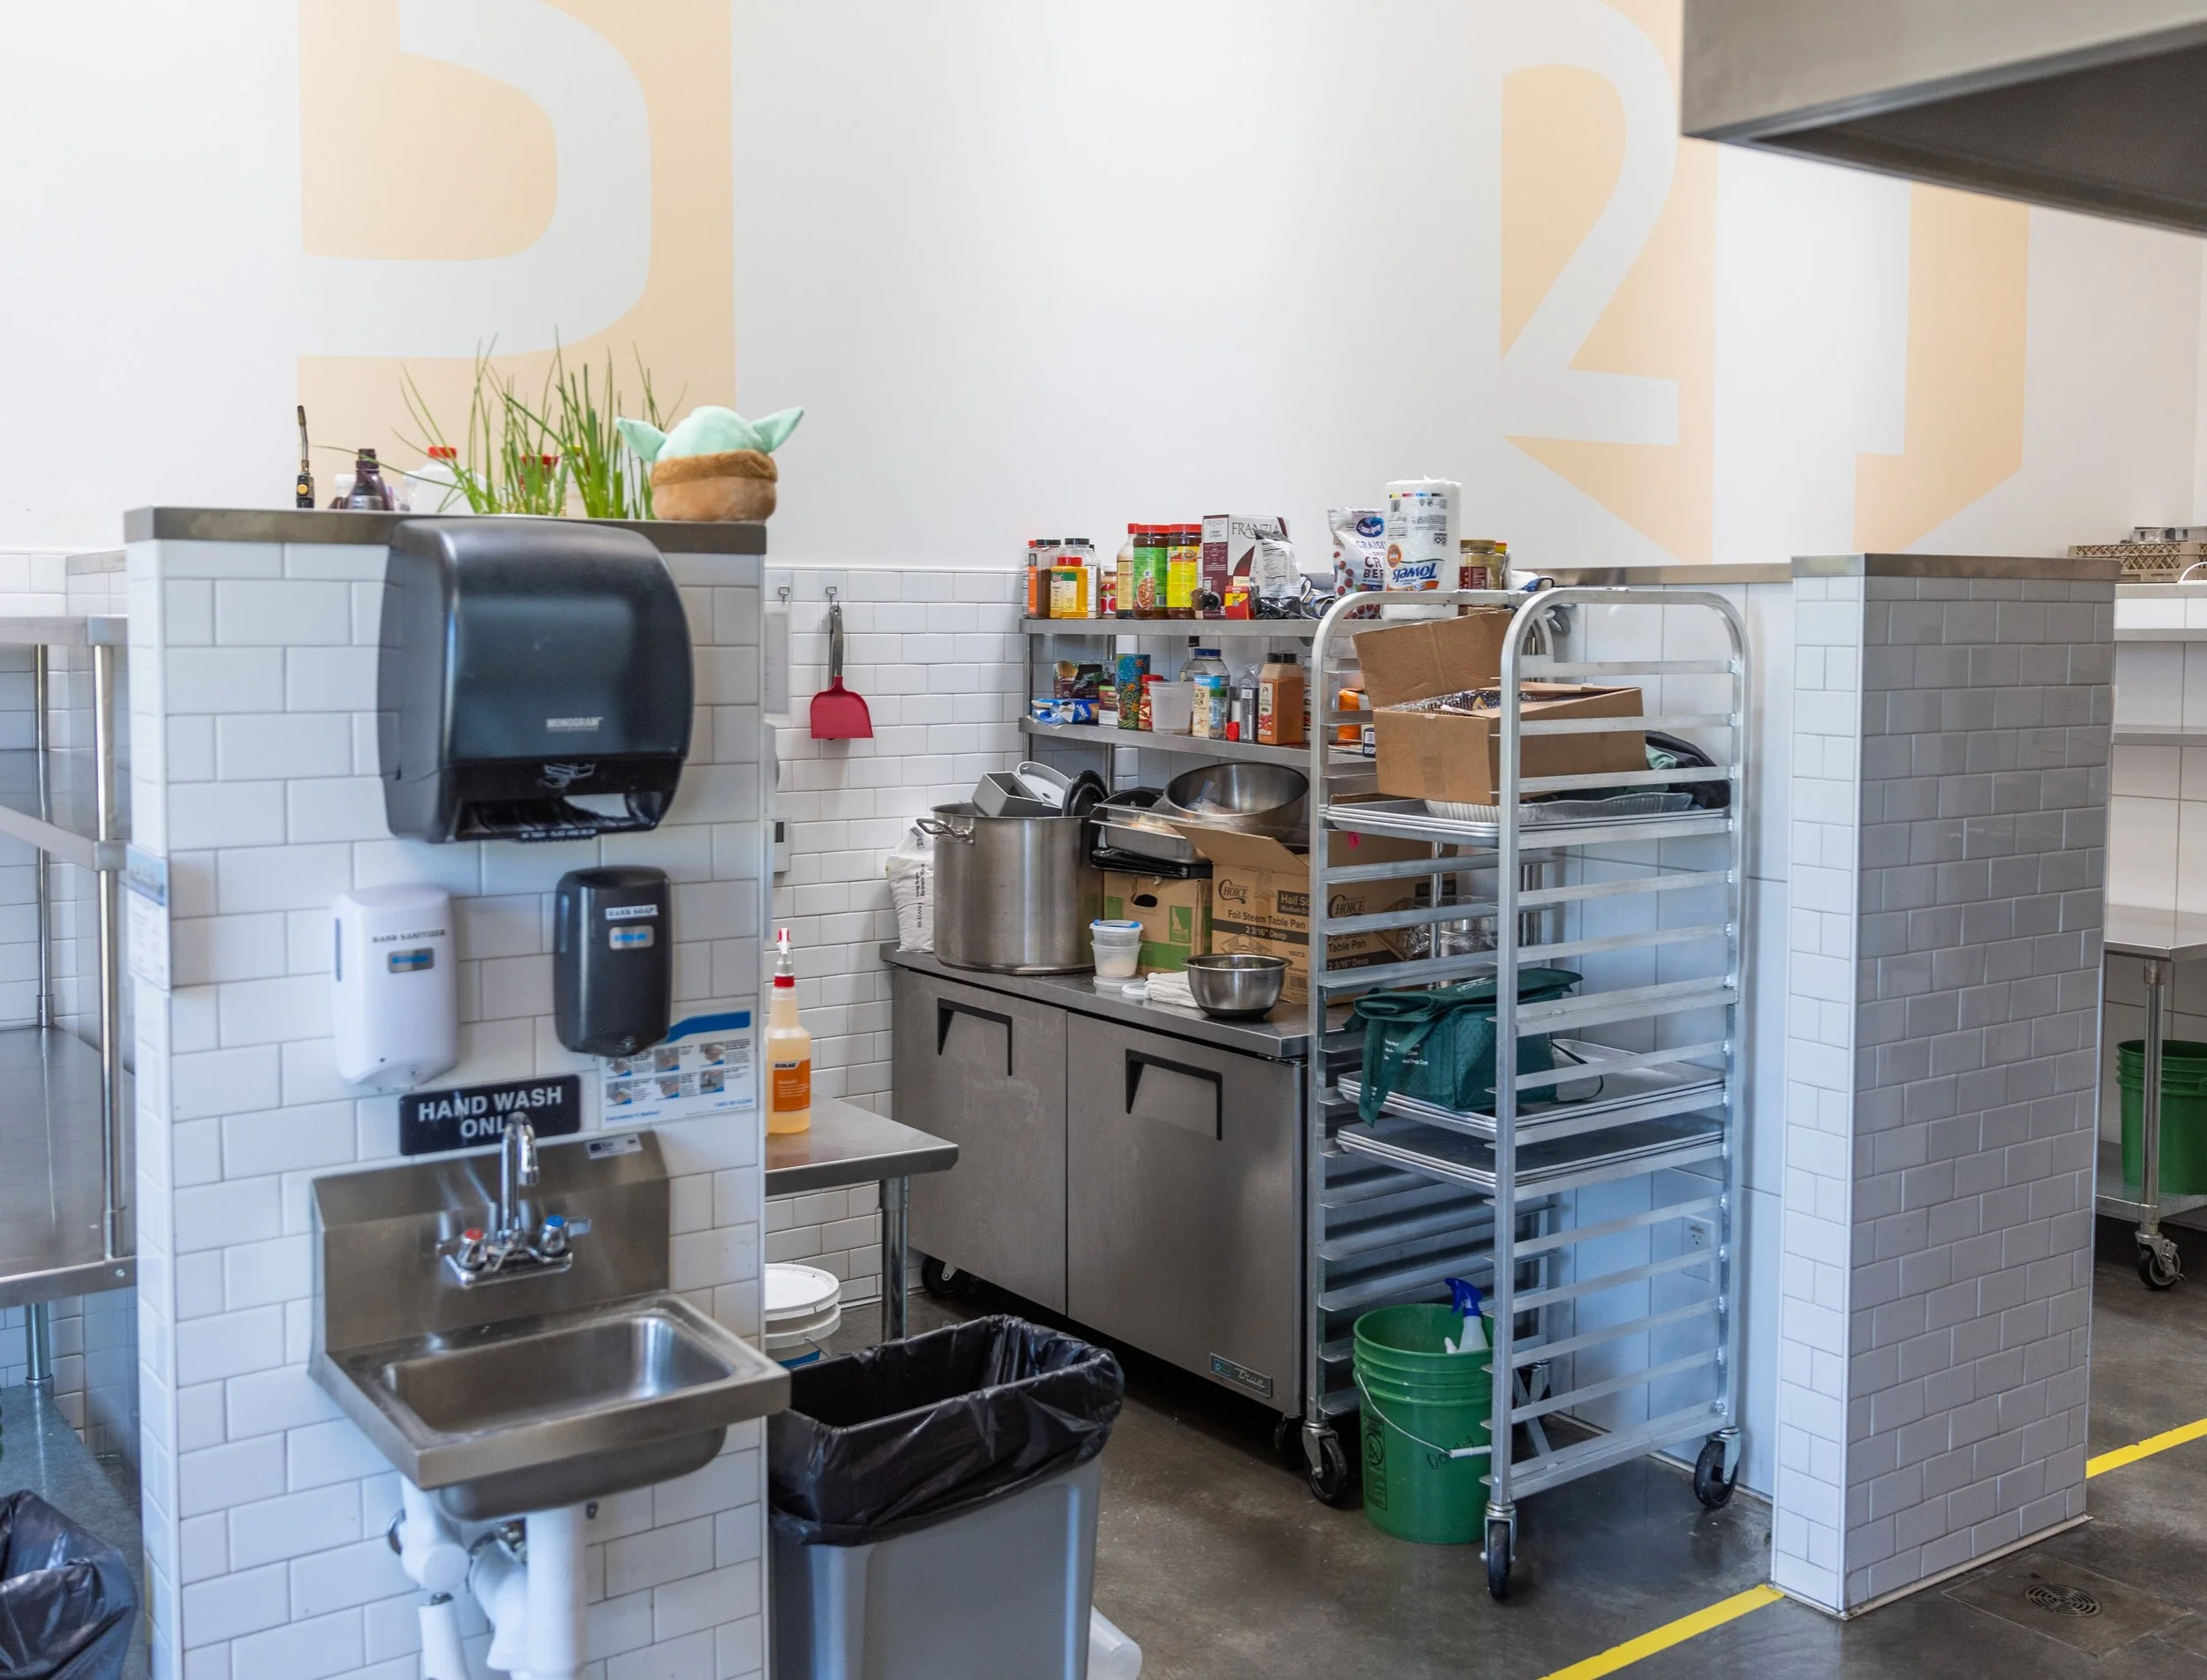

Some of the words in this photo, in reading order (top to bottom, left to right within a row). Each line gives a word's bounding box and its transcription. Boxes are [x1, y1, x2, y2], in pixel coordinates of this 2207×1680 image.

[1392, 562, 1437, 583] Towels
[1218, 878, 1249, 905] CHOICE
[1280, 893, 1299, 905] Half
[1328, 893, 1367, 919] CHOICE
[1228, 909, 1241, 919] Foil
[1243, 911, 1267, 924] Steam
[1269, 915, 1289, 928] Table
[1291, 919, 1306, 930] Pan
[1269, 930, 1287, 941] Deep
[1328, 941, 1351, 953] Table
[1352, 938, 1366, 950] Pan
[418, 1096, 487, 1122] HAND
[493, 1085, 562, 1111] WASH
[460, 1115, 507, 1138] ONL
